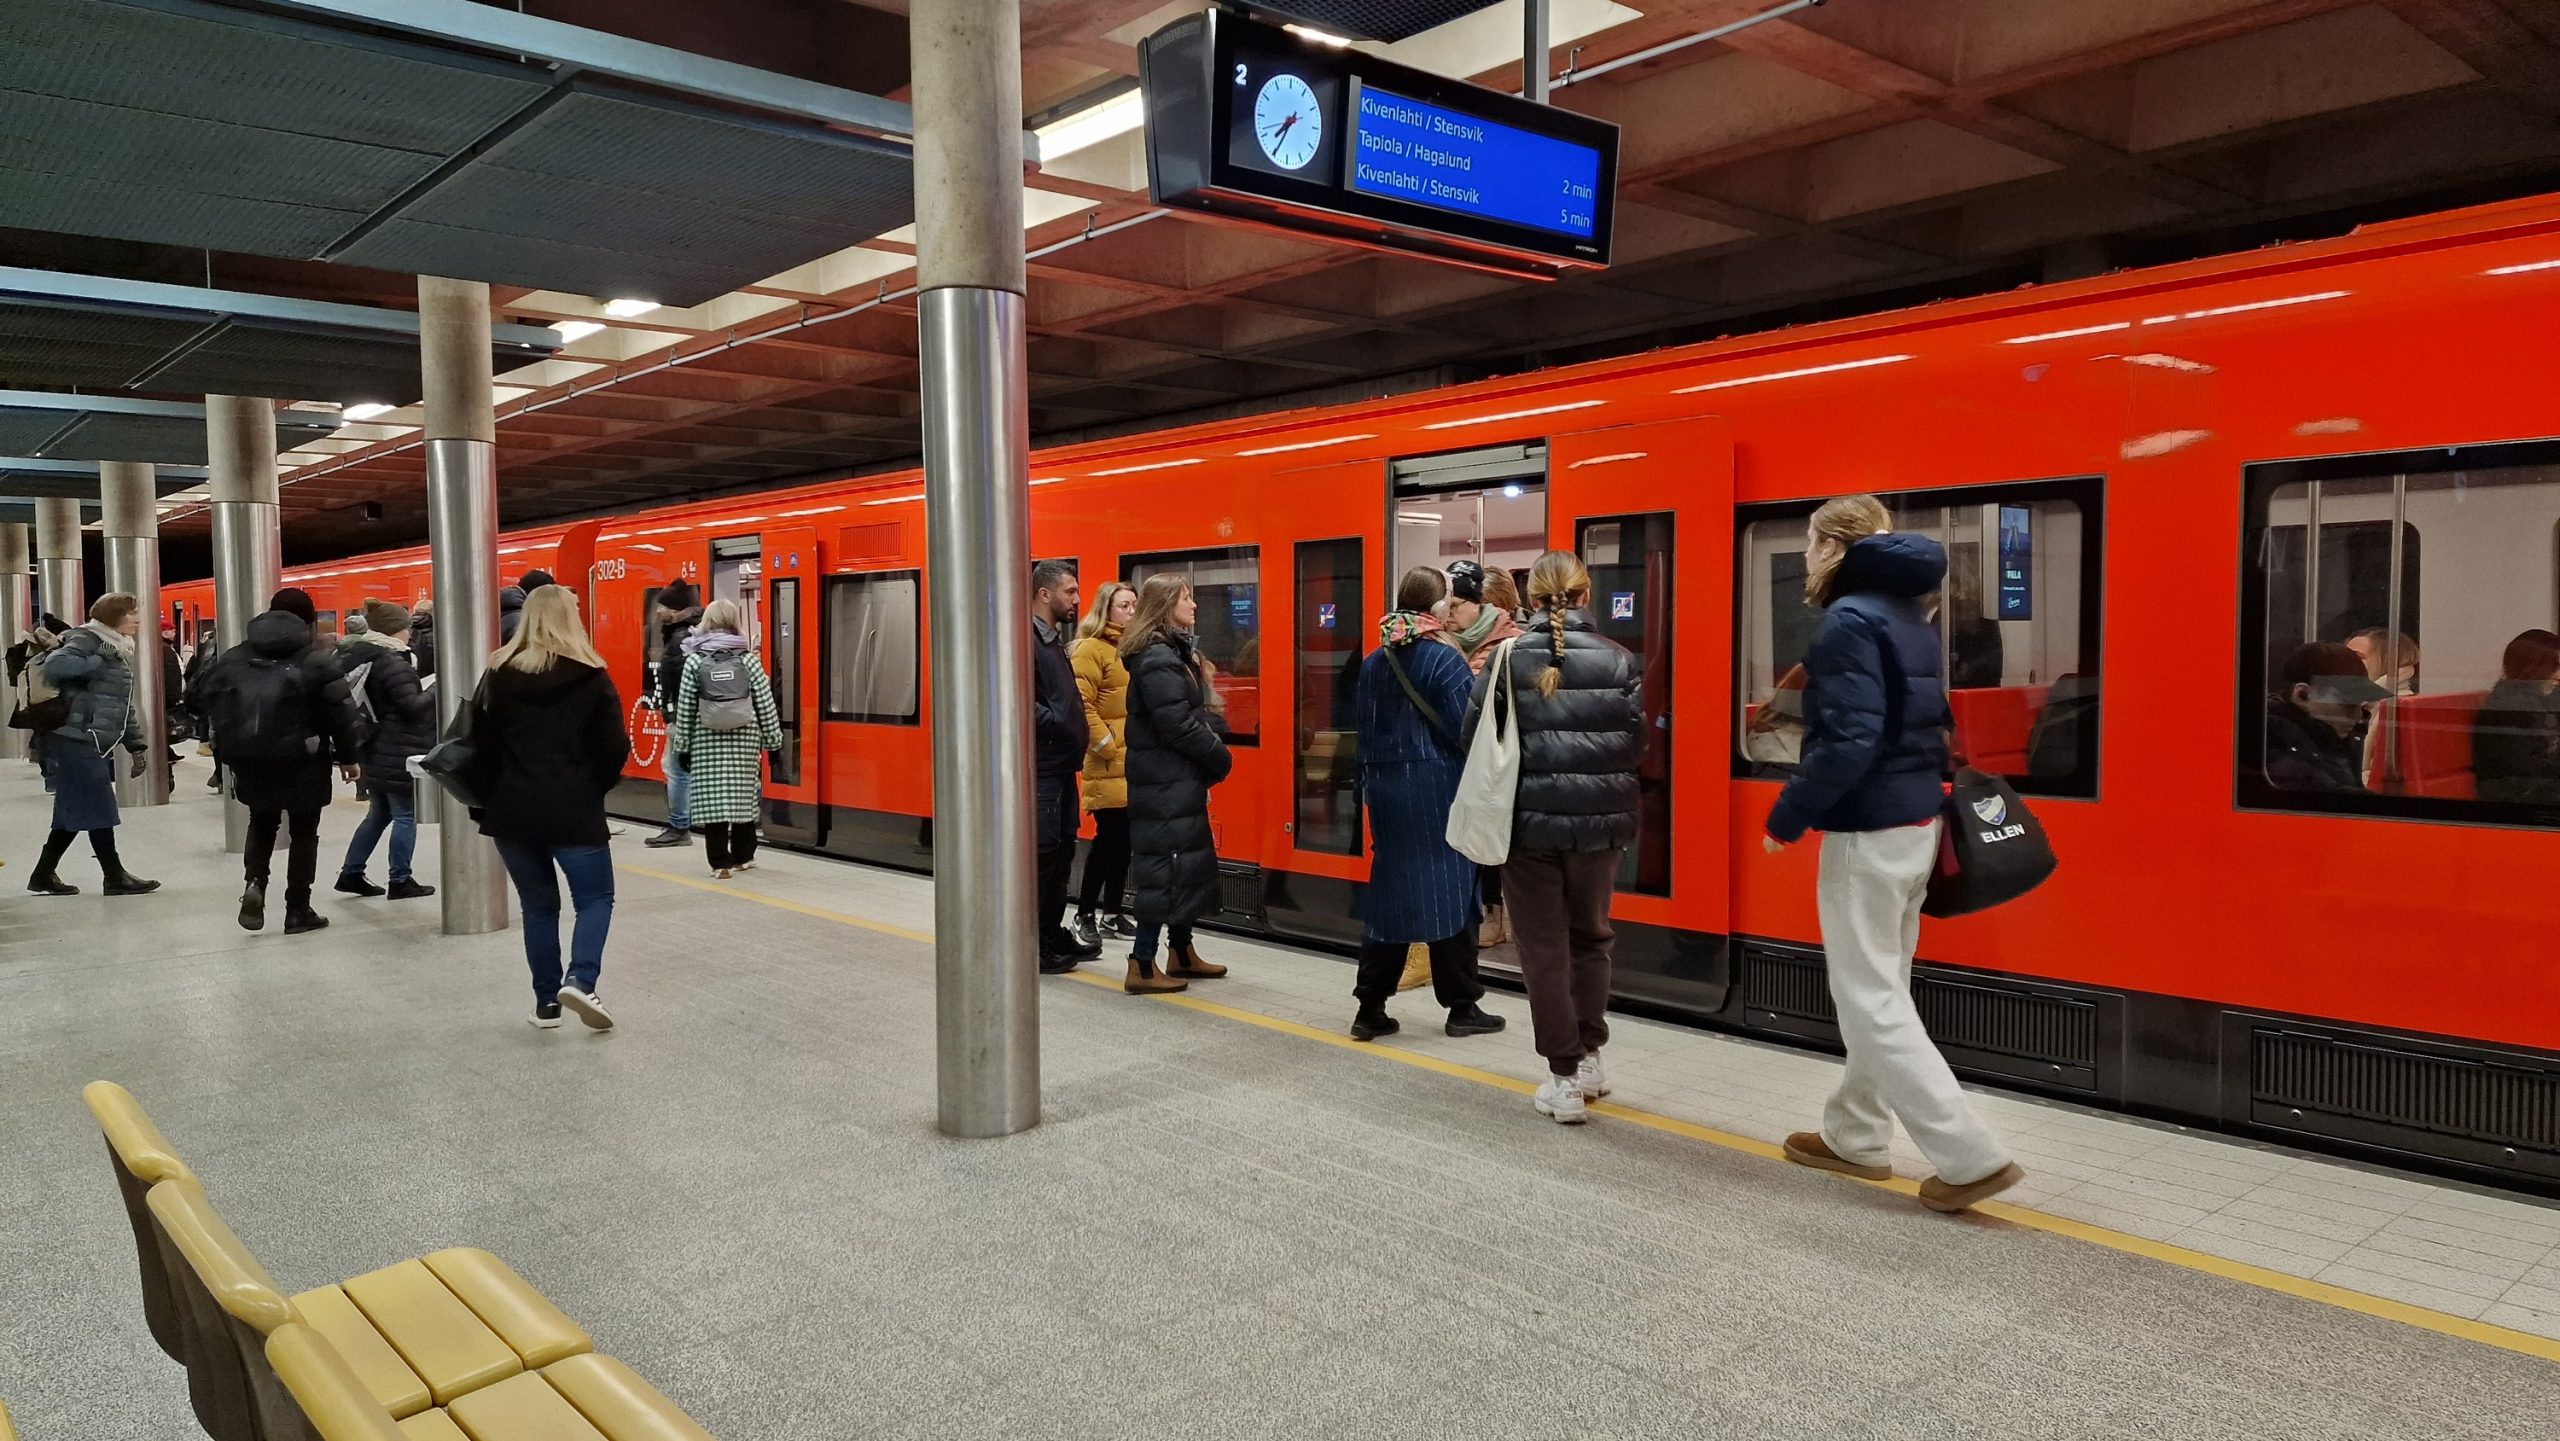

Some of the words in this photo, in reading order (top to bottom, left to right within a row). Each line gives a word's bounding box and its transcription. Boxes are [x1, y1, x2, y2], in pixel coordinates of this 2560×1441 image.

[1235, 63, 1247, 86] 2
[1361, 96, 1423, 127] Kivenlahti
[1425, 114, 1432, 131] /
[1434, 116, 1484, 143] Stensvik
[1359, 129, 1403, 155] Tapiola
[1405, 142, 1412, 158] /
[1414, 144, 1471, 171] Hagalund
[1357, 162, 1419, 191] Kivenlahti
[1421, 178, 1428, 194] /
[1430, 179, 1480, 204] Stensvik
[1562, 180, 1570, 195] 2
[1572, 184, 1592, 200] min
[1561, 209, 1568, 224] 5
[1570, 213, 1590, 228] min
[597, 557, 626, 581] 302-B
[1980, 823, 2026, 844] ELLEN
